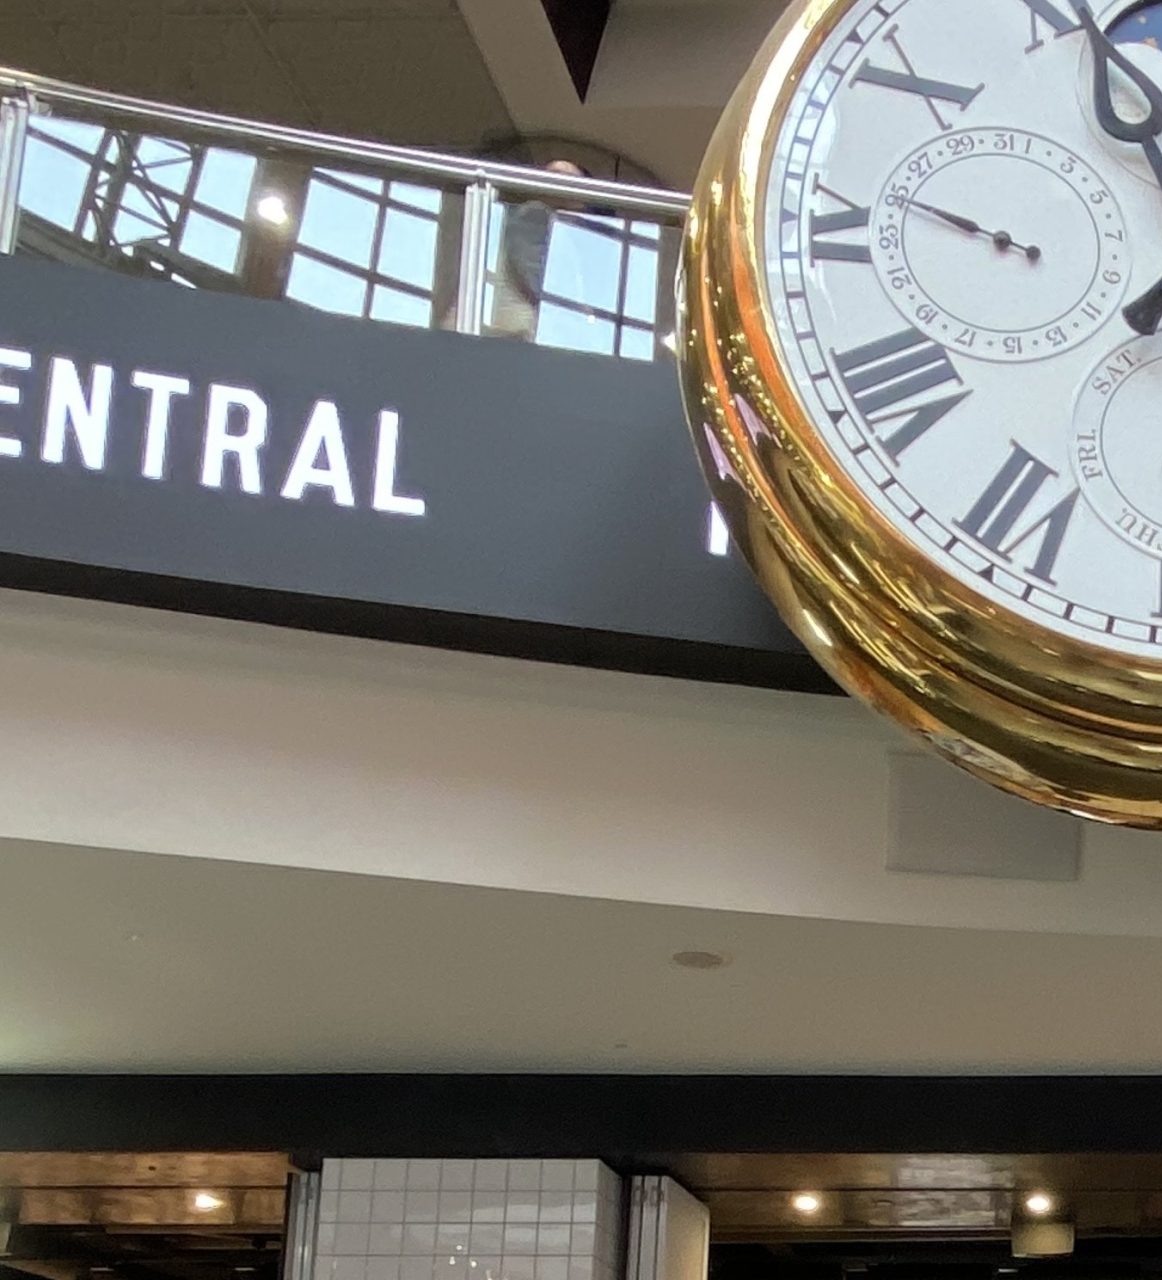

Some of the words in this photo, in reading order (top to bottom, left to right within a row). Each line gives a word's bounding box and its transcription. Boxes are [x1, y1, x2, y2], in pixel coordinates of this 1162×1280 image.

[946, 134, 975, 155] 29
[993, 133, 1015, 151] 31
[1025, 137, 1032, 154] 1
[907, 152, 934, 178] 27
[1059, 156, 1078, 174] 3
[1089, 189, 1109, 205] 5
[879, 223, 899, 251] 23
[1104, 229, 1124, 243] 7
[887, 265, 913, 290] 21
[1102, 270, 1122, 285] 9
[915, 303, 939, 326] 19
[1080, 301, 1102, 321] 11
[954, 330, 977, 348] 17
[1002, 336, 1023, 355] 15
[1045, 326, 1069, 347] 13
